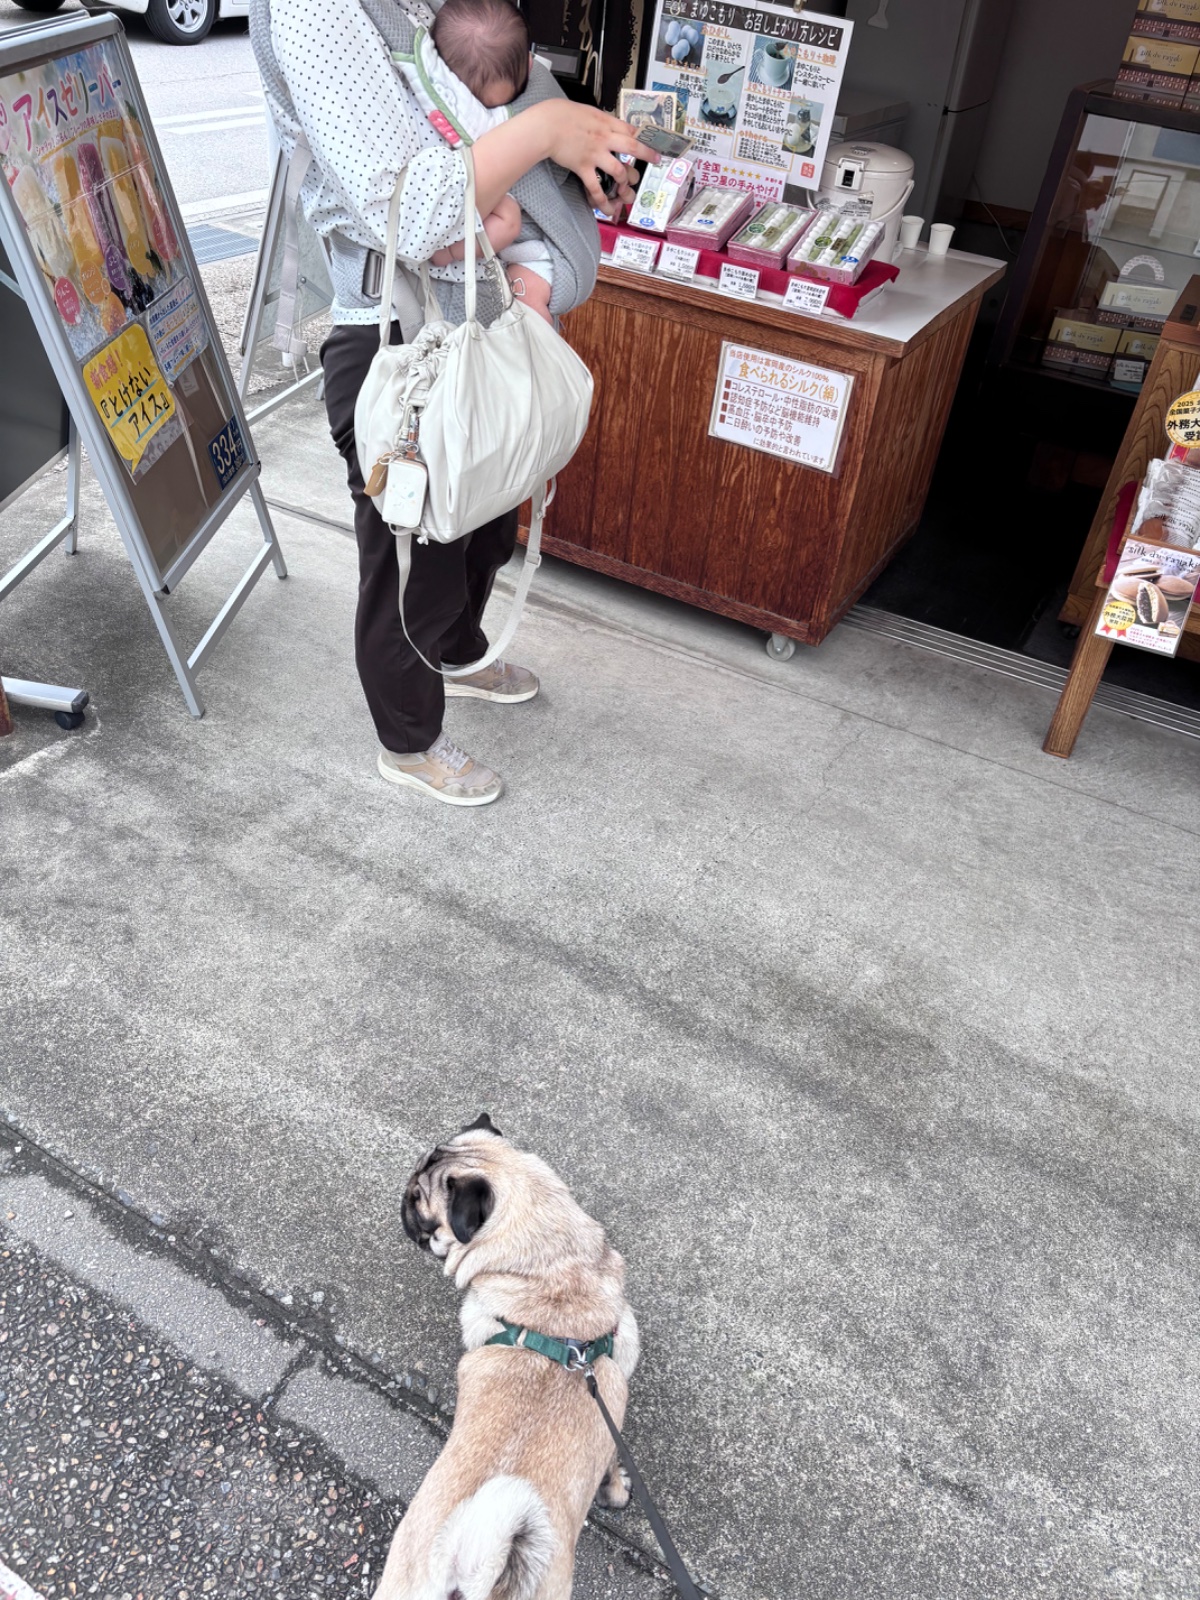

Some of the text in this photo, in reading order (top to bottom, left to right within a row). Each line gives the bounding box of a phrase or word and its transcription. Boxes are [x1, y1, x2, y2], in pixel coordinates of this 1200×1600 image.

[690, 1, 736, 26] まゆこもり
[744, 12, 839, 47] お召し上がり方レシピ
[13, 65, 122, 152] アイスゼリーバー
[100, 367, 152, 419] 『とけない
[731, 381, 839, 421] コレステロール・中性脂肪の改善
[738, 361, 840, 404] 食べられるシルク(絹)
[128, 391, 171, 437] アイス』
[727, 403, 793, 433] 高血圧・脳卒中予防
[729, 391, 821, 428] 認知症予防など脳機能維持
[1177, 400, 1194, 408] 2025
[725, 415, 802, 446] 二日酔いの予防や改善
[753, 437, 826, 465] に効果的と言われています
[1128, 546, 1147, 557] silk
